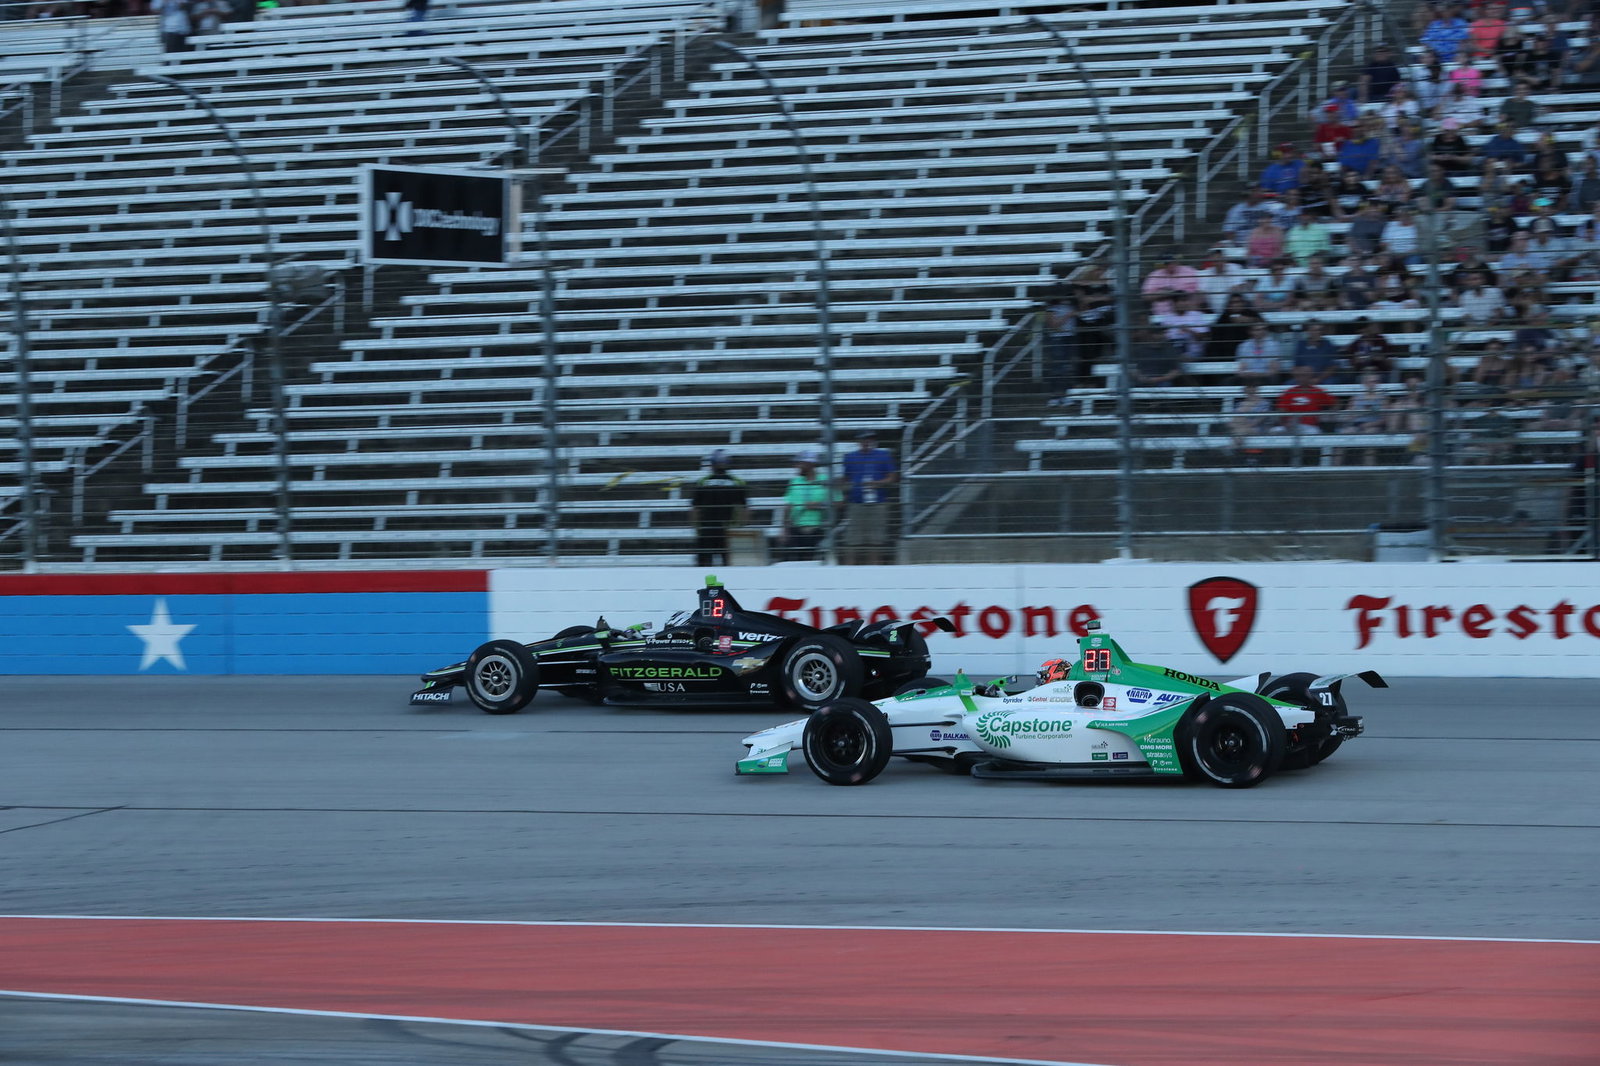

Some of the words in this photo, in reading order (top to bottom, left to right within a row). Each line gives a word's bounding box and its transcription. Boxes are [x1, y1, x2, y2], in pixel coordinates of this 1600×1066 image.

[738, 632, 787, 642] veriz
[889, 630, 897, 642] 2
[1084, 649, 1111, 672] 27
[609, 667, 723, 678] FITZGERALD
[1163, 667, 1221, 692] HONDA
[658, 682, 686, 692] USA
[412, 692, 450, 700] HITACHI
[1129, 689, 1149, 699] NAPA
[1319, 692, 1333, 706] 27
[989, 717, 1073, 736] Capstone
